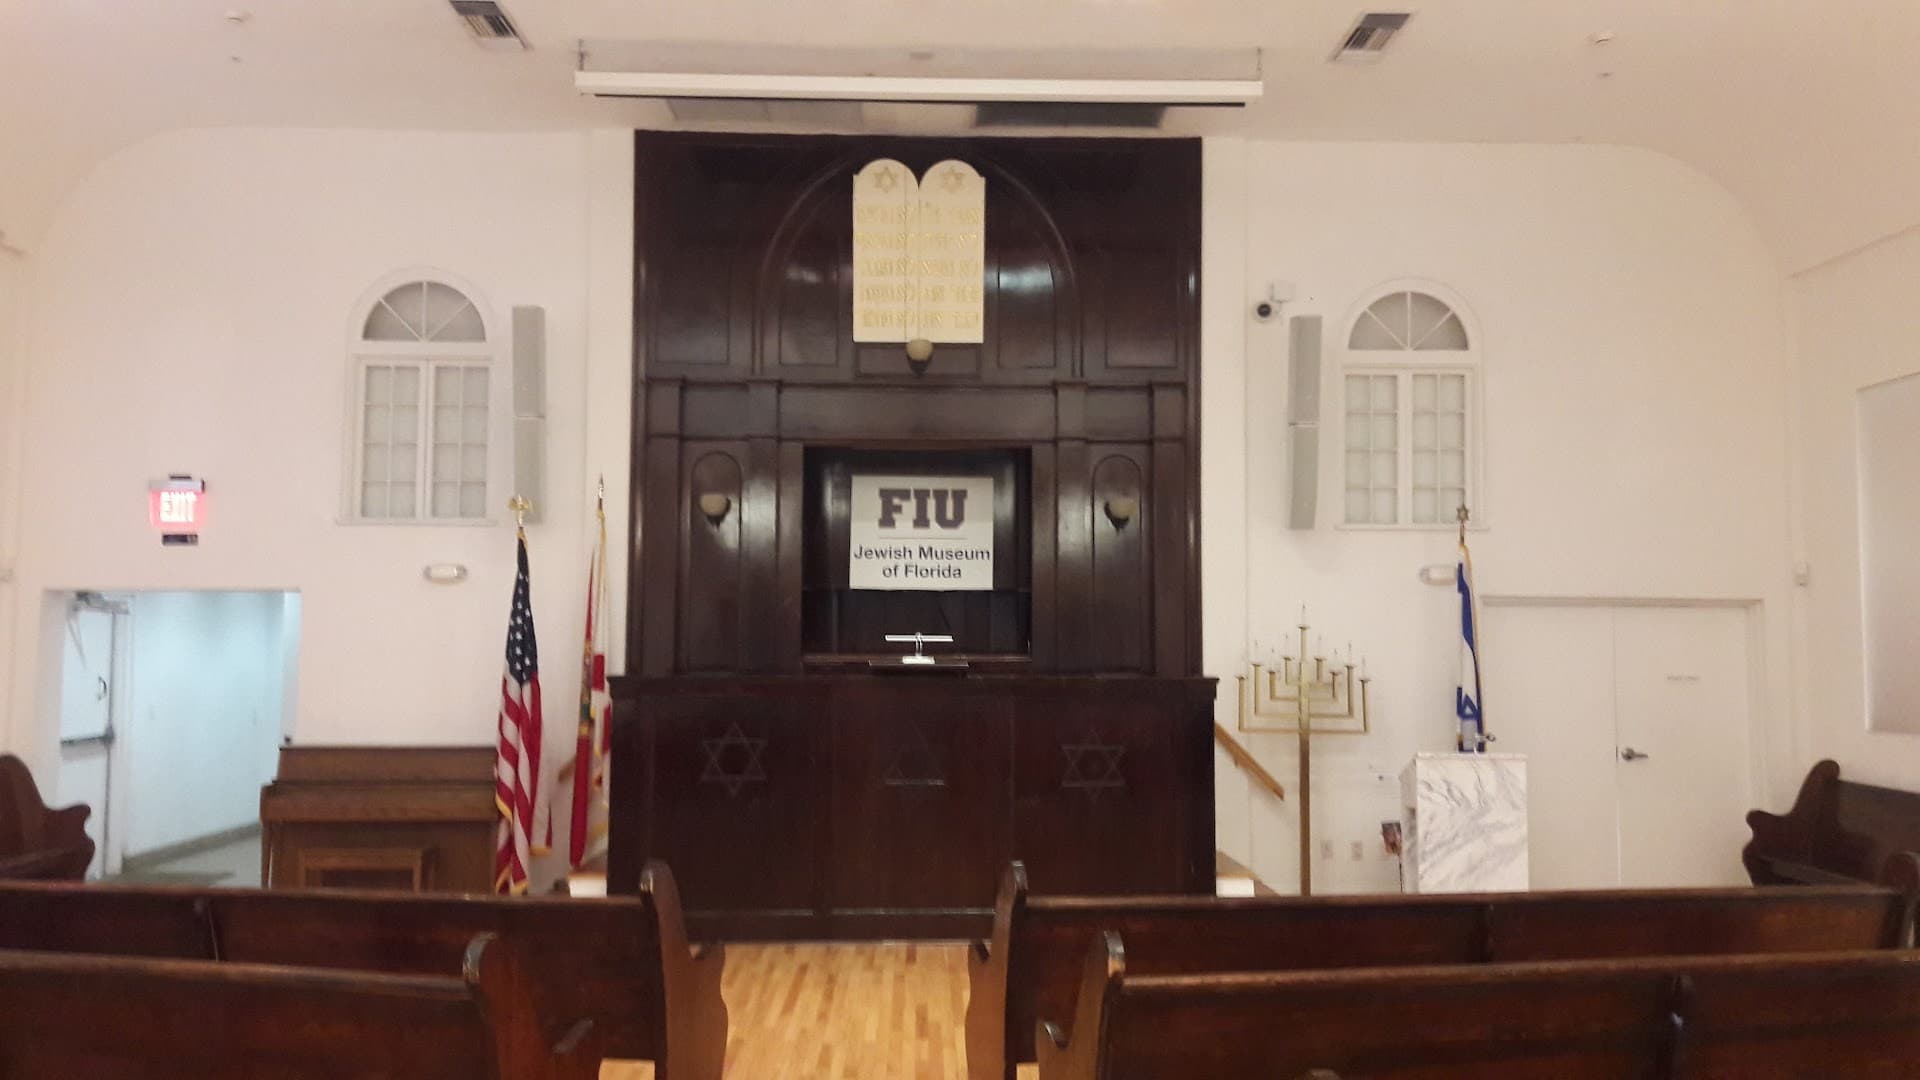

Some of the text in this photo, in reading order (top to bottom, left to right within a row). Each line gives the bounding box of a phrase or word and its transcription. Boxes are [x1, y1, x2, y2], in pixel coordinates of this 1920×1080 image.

[878, 488, 968, 529] FIU
[854, 544, 990, 561] Jewish Museum
[882, 564, 962, 579] of Florida
